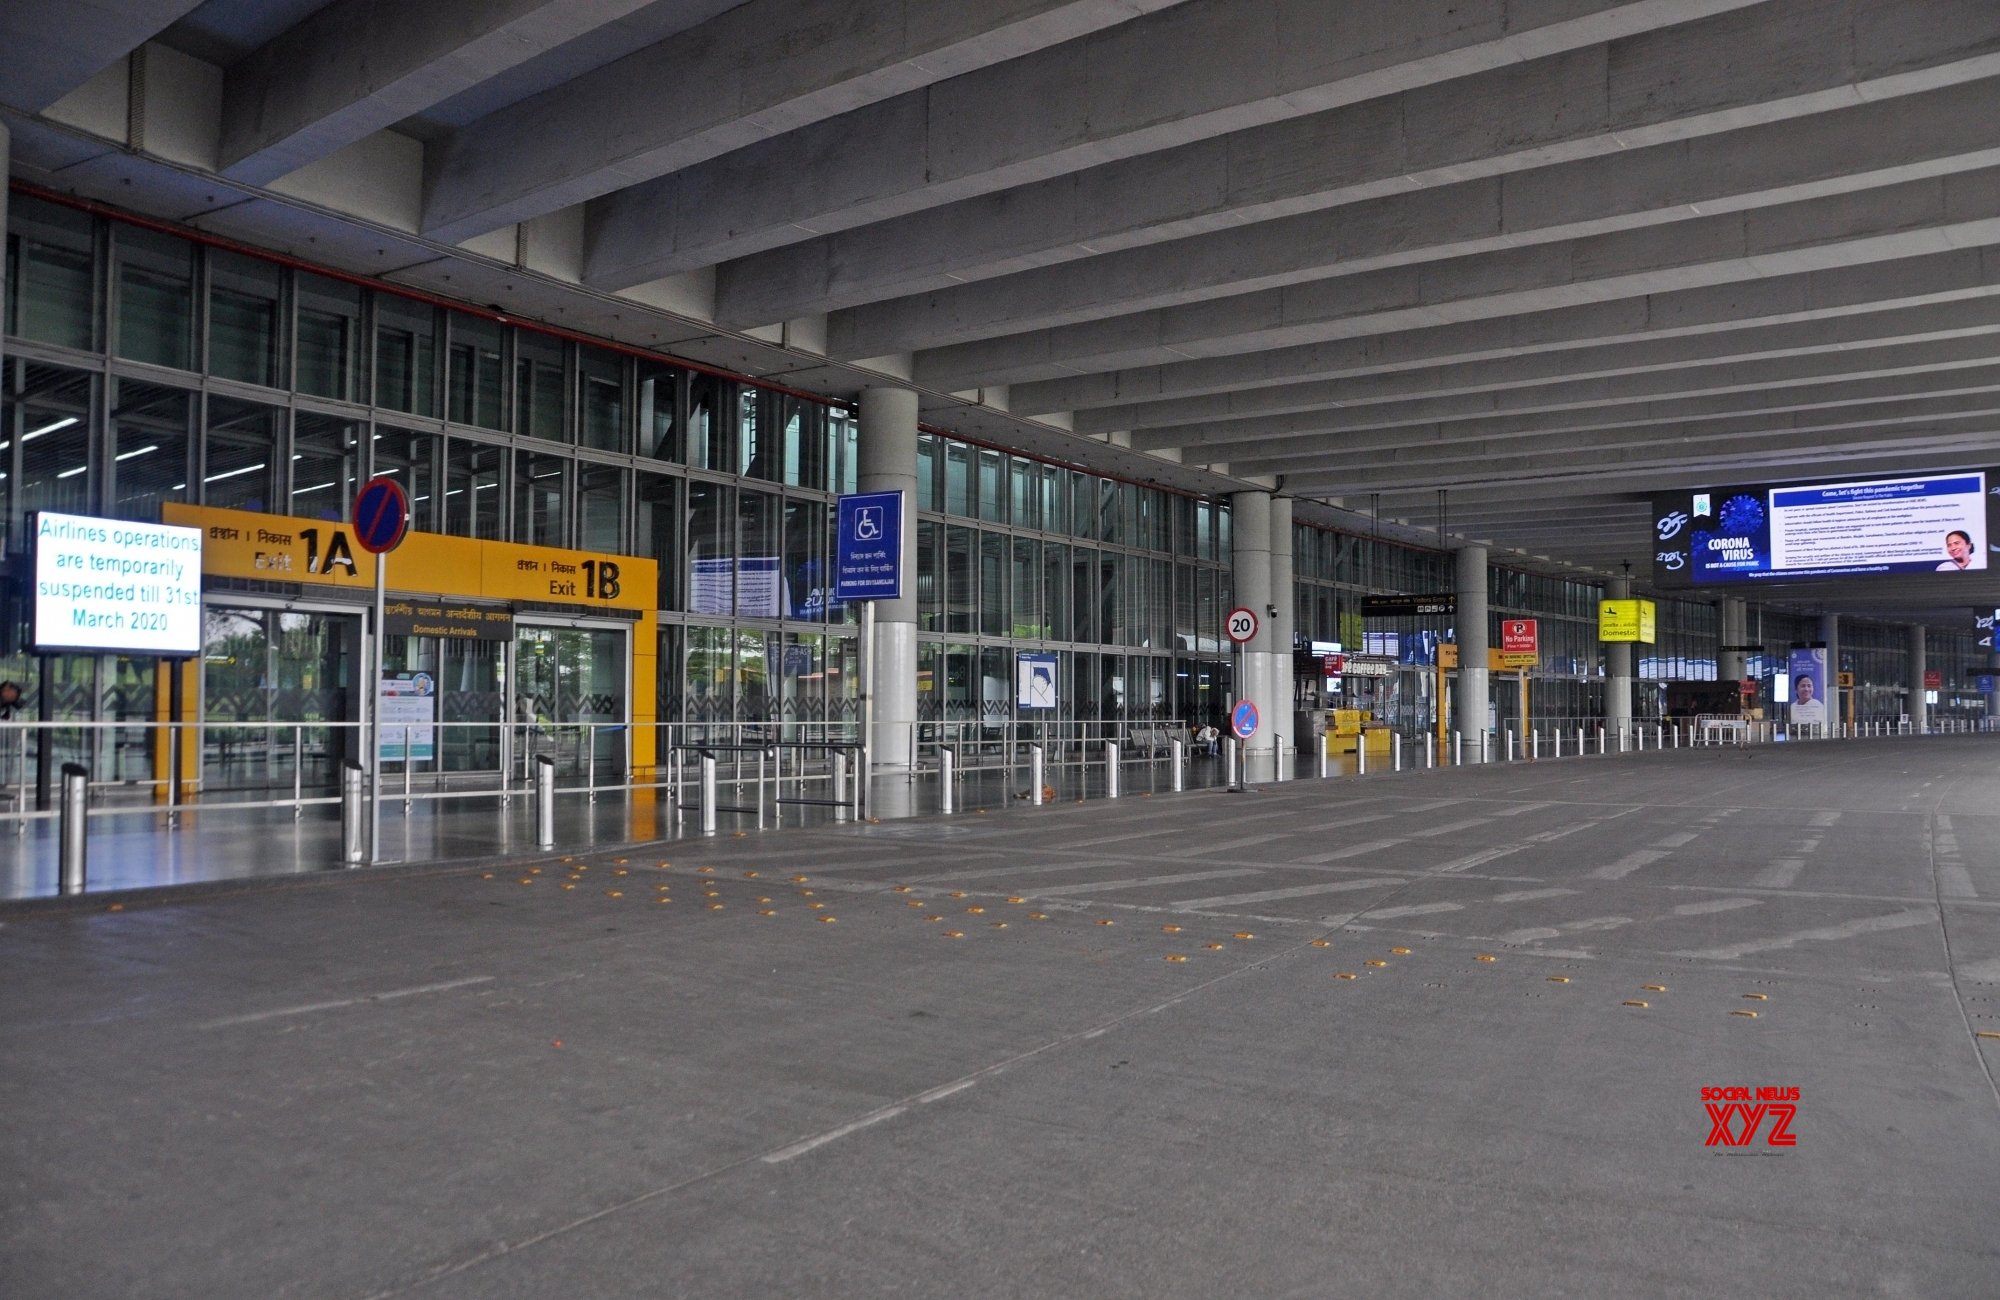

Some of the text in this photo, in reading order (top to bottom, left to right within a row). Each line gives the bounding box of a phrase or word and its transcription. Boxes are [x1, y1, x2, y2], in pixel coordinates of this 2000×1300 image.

[40, 518, 199, 551] Airlines operations
[258, 529, 292, 546] निकास
[300, 528, 358, 576] 1A
[1708, 537, 1750, 550] CORONA
[256, 552, 292, 572] Exit
[1722, 548, 1754, 560] VIRUS
[57, 554, 184, 581] are temporarily
[552, 561, 576, 574] निकास
[550, 580, 576, 596] Exit
[582, 560, 620, 599] 1B
[40, 582, 198, 605] suspended till 31st
[73, 608, 168, 630] March 2020
[1232, 618, 1250, 632] 20
[413, 624, 477, 636] Domestic Arrivals
[1514, 635, 1534, 643] Parking
